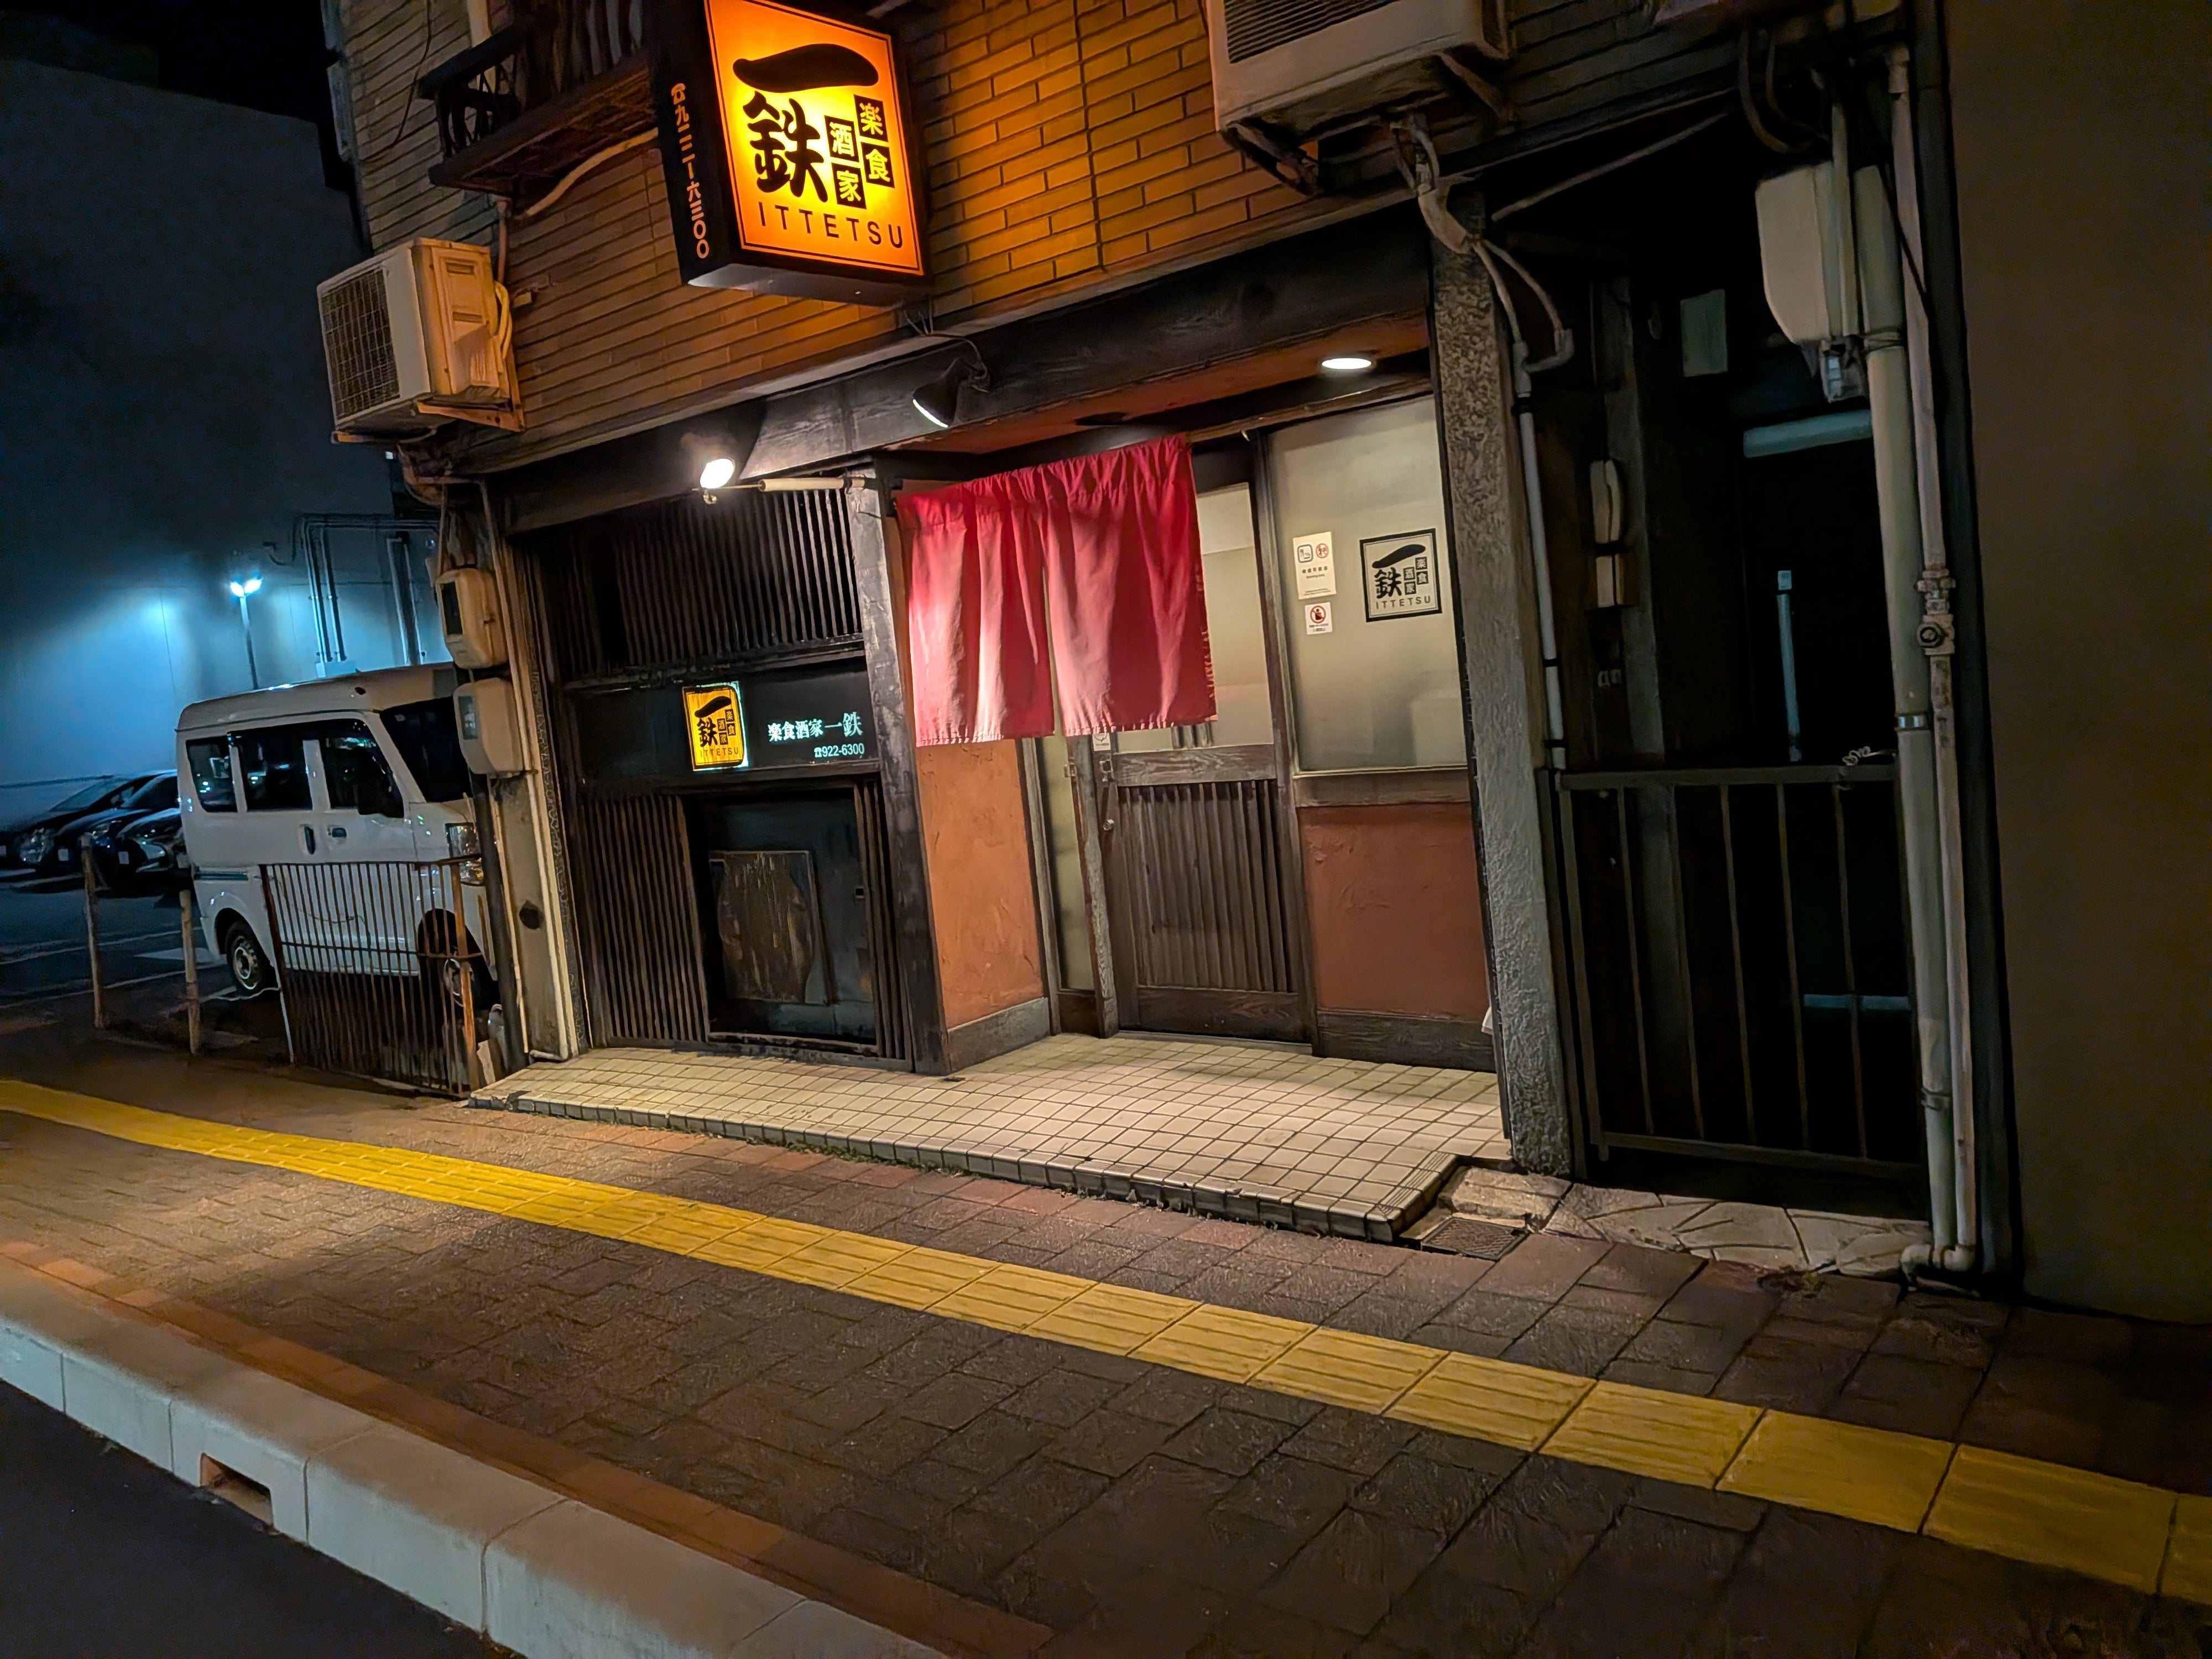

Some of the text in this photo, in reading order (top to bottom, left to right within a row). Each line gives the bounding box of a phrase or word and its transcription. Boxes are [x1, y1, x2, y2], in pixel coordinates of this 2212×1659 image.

[758, 201, 903, 249] ITTETSU
[1375, 595, 1431, 609] ITTETSU
[700, 747, 739, 758] ITTETSU
